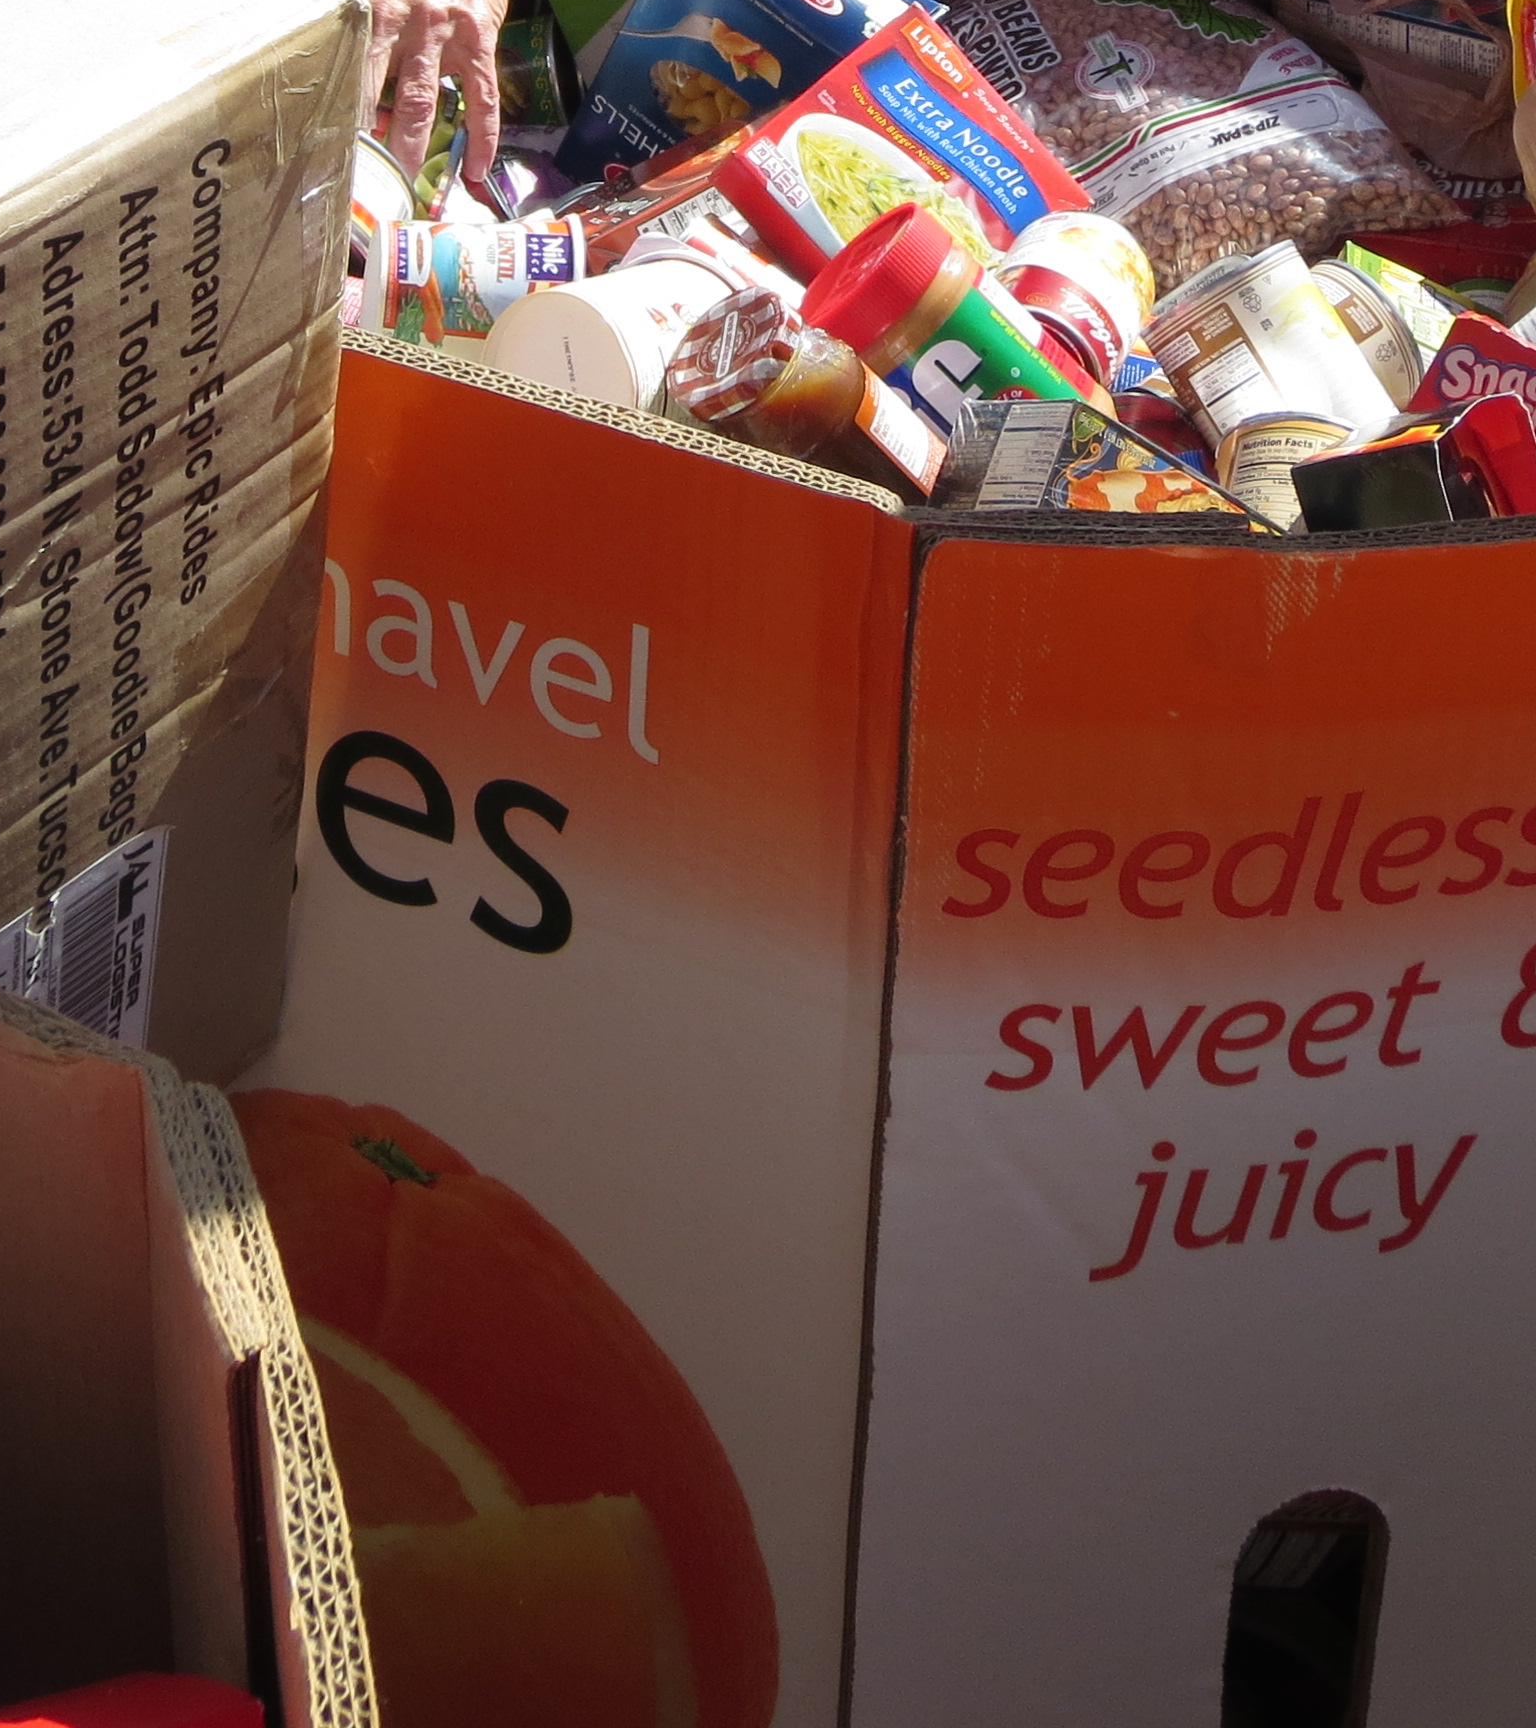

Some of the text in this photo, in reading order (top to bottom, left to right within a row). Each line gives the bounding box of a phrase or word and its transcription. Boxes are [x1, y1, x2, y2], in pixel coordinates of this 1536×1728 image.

[850, 84, 868, 106] Now
[866, 102, 888, 128] With
[884, 121, 917, 153] Bigger
[914, 147, 953, 182] Noodles
[894, 76, 1030, 200] Extra Noodle
[909, 24, 965, 84] Lipton
[973, 87, 999, 115] Soup
[997, 114, 1030, 152] Secrets
[1256, 115, 1281, 131] ZIP
[877, 83, 1018, 215] Soup Mix with Real Chicken Broth
[118, 185, 160, 306] Attn:
[398, 228, 408, 281] LOW FAT
[526, 236, 540, 275] spice
[542, 236, 568, 275] Nile
[118, 298, 161, 424] Todd
[179, 137, 232, 606] Company: Epic Rides
[1242, 436, 1314, 452] Nutrition Facts
[41, 493, 85, 549] N.
[39, 546, 83, 685] Stone
[122, 912, 149, 1012] SUPER
[985, 959, 1441, 1092] sweet
[1089, 1128, 1479, 1282] juicy
